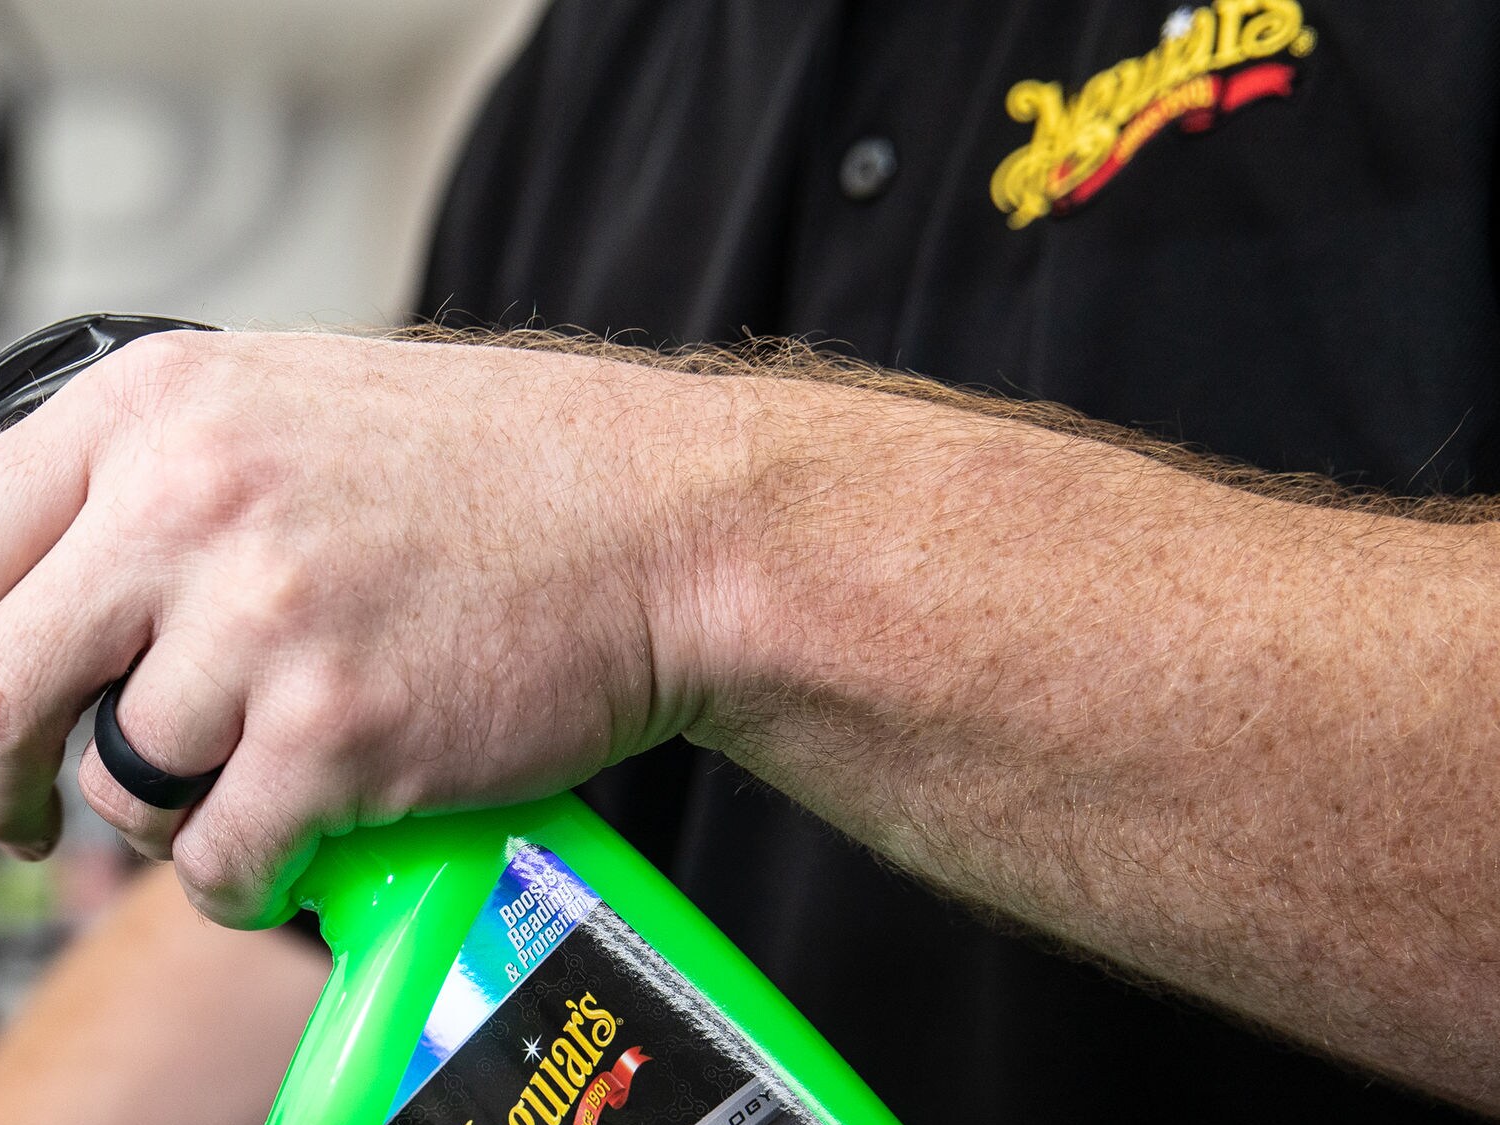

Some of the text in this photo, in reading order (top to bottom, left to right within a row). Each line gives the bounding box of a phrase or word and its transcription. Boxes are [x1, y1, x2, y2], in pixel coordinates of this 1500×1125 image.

[499, 868, 559, 929] Boosts
[506, 882, 576, 952] Beading
[504, 895, 591, 984] & Protection
[587, 1078, 612, 1111] 1901
